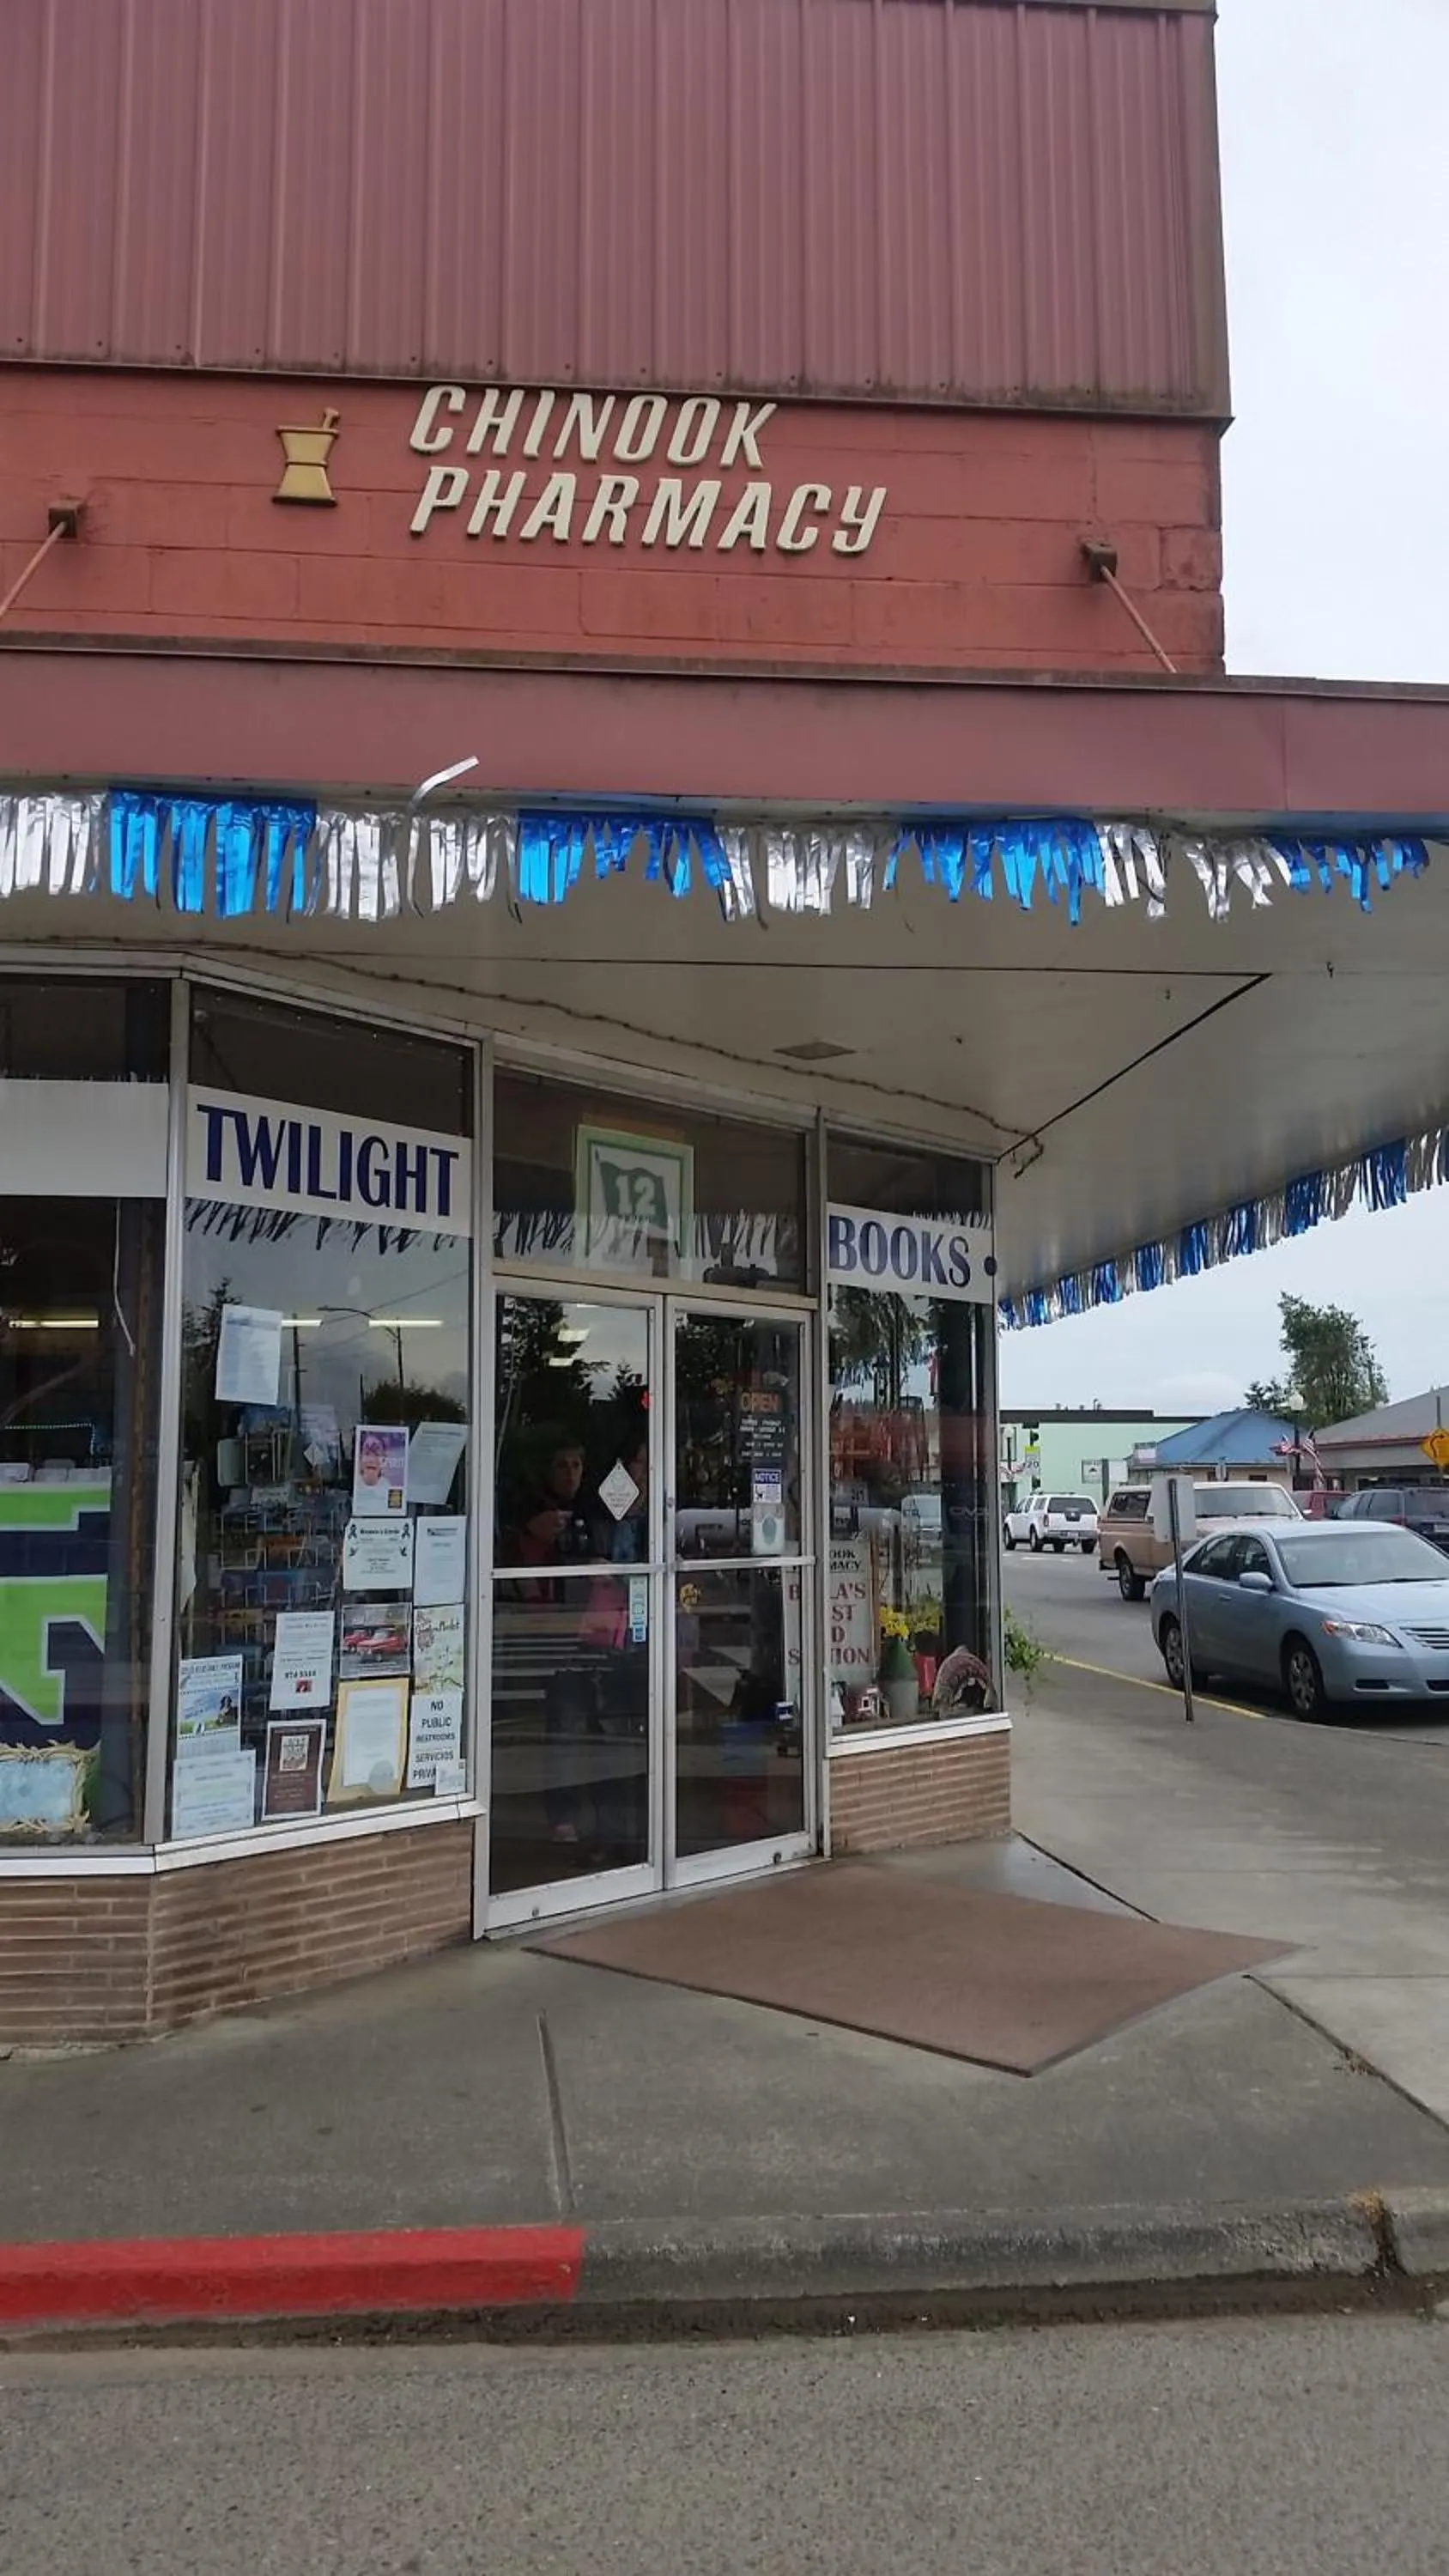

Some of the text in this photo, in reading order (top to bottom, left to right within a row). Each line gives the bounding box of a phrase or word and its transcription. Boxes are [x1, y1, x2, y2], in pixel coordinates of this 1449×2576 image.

[409, 385, 777, 469] CHINOOK
[409, 465, 887, 554] PHARMACY
[197, 1103, 459, 1217] TWILIGHT
[615, 1174, 657, 1217] 12
[829, 1214, 972, 1288] BOOKS
[741, 1392, 779, 1413] OPEN
[755, 1472, 779, 1483] NOTICE
[421, 1716, 452, 1728] PUBLIC
[430, 1700, 444, 1711] NO
